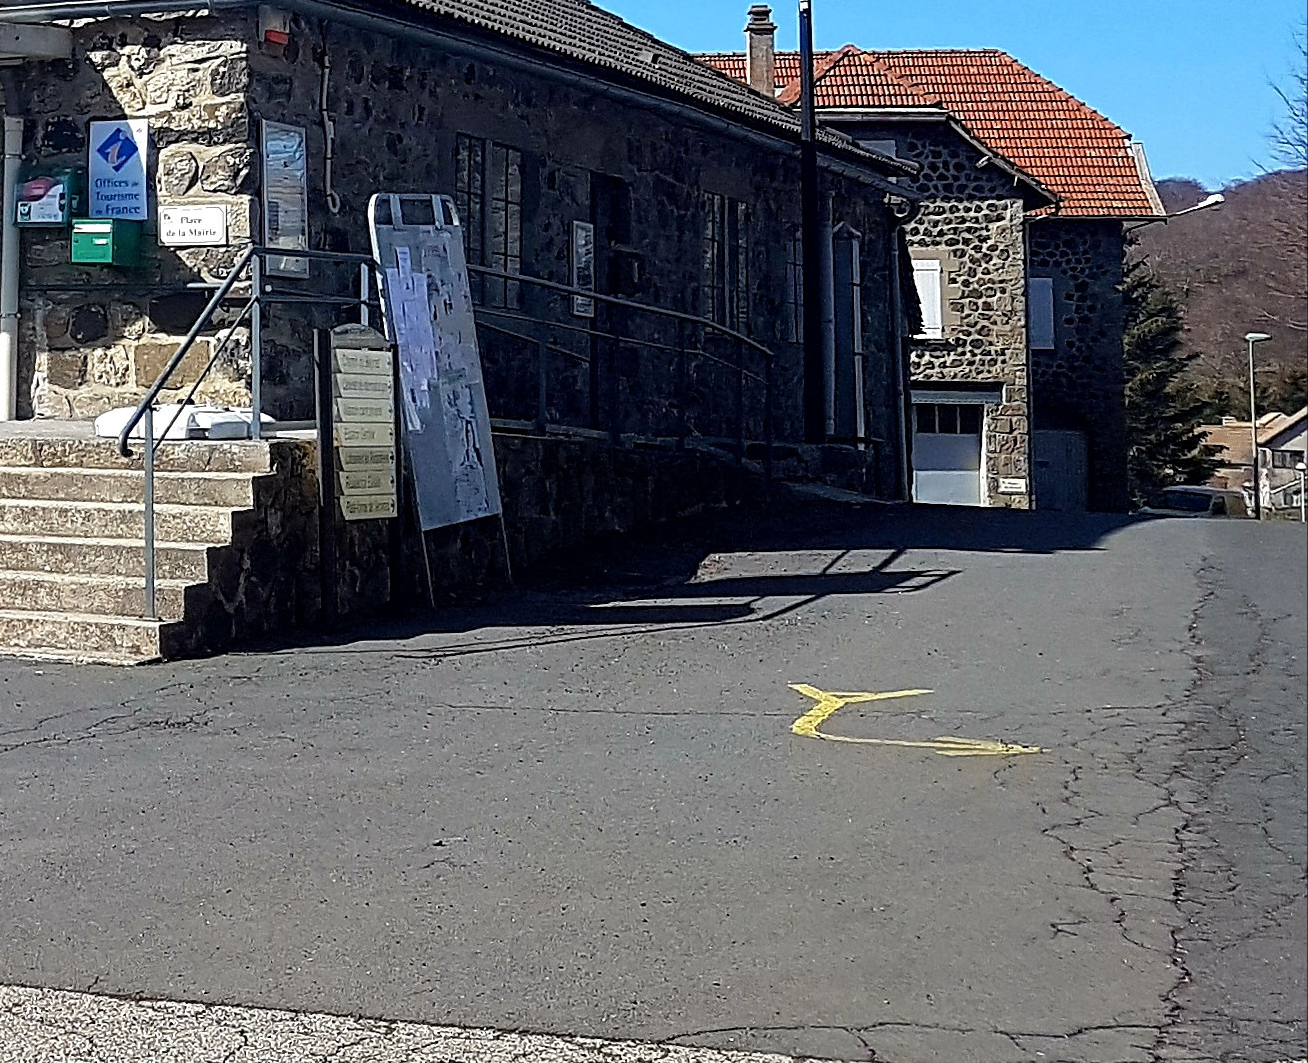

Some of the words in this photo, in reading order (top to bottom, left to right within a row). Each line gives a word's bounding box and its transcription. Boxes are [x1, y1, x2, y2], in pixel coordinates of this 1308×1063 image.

[94, 178, 129, 188] Offices
[95, 191, 140, 202] Tourisme
[105, 204, 141, 215] France
